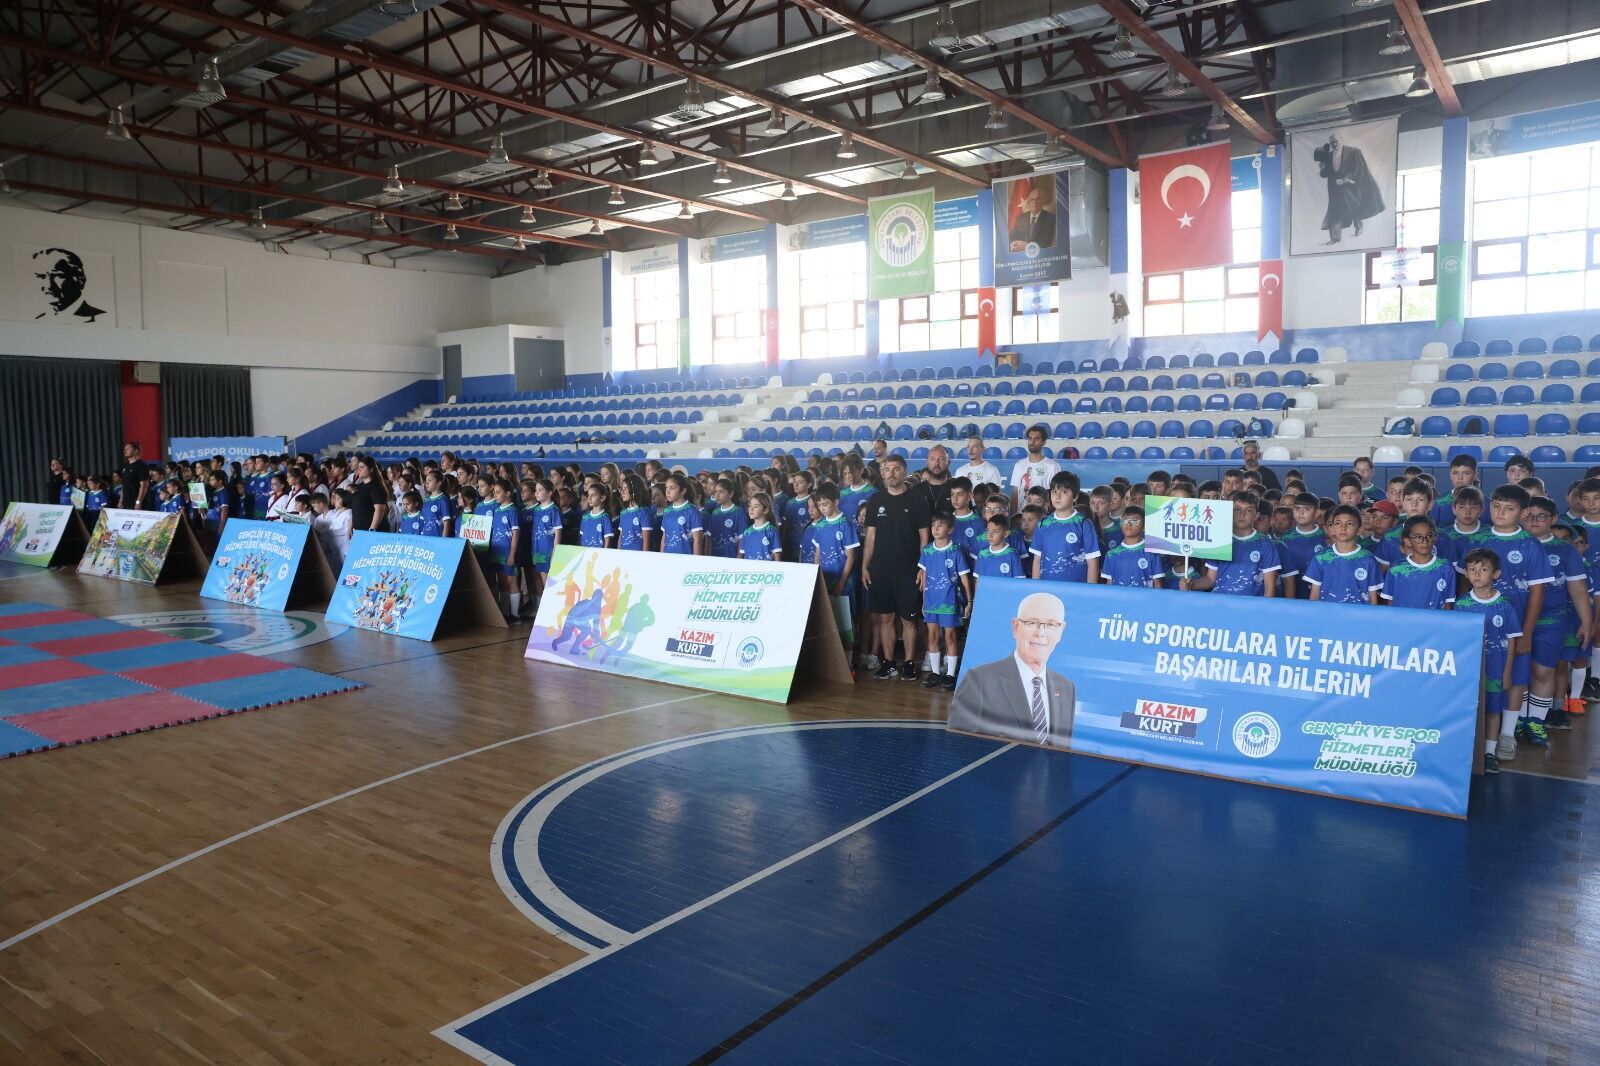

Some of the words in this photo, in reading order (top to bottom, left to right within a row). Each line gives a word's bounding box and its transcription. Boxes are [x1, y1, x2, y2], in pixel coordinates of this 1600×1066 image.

[175, 449, 196, 460] YAZ
[196, 447, 226, 458] SPOR
[271, 532, 288, 545] SPOR
[1164, 522, 1212, 543] FUTBOL
[369, 542, 405, 557] GENÇLİK
[404, 545, 413, 555] VE
[413, 547, 435, 562] SPOR
[352, 555, 397, 570] HİZMETLERİ
[397, 556, 444, 581] MÜDÜRLÜĞÜ
[683, 569, 733, 588] GENÇLİK
[734, 573, 749, 585] VE
[748, 573, 783, 585] SPOR
[693, 588, 763, 603] HİZMETLERİ
[687, 606, 761, 621] MÜDÜRLÜĞÜ
[680, 629, 715, 644] KAZIM
[1098, 613, 1140, 643] TÜM
[1142, 621, 1278, 657] SPORCULARA
[1285, 634, 1313, 661] VE
[1318, 637, 1457, 677] TAKIMLARA
[677, 641, 706, 655] KURT
[1154, 651, 1272, 688] BAŞARILAR
[1141, 701, 1197, 722] KAZIM
[1138, 716, 1184, 735] KURT
[1303, 721, 1371, 739] GENÇLİK
[1371, 726, 1393, 739] VE
[1393, 728, 1440, 743] SPOR
[1320, 740, 1415, 759] HİZMETLERİ
[1315, 756, 1416, 777] MÜDÜRLÜĞÜ
